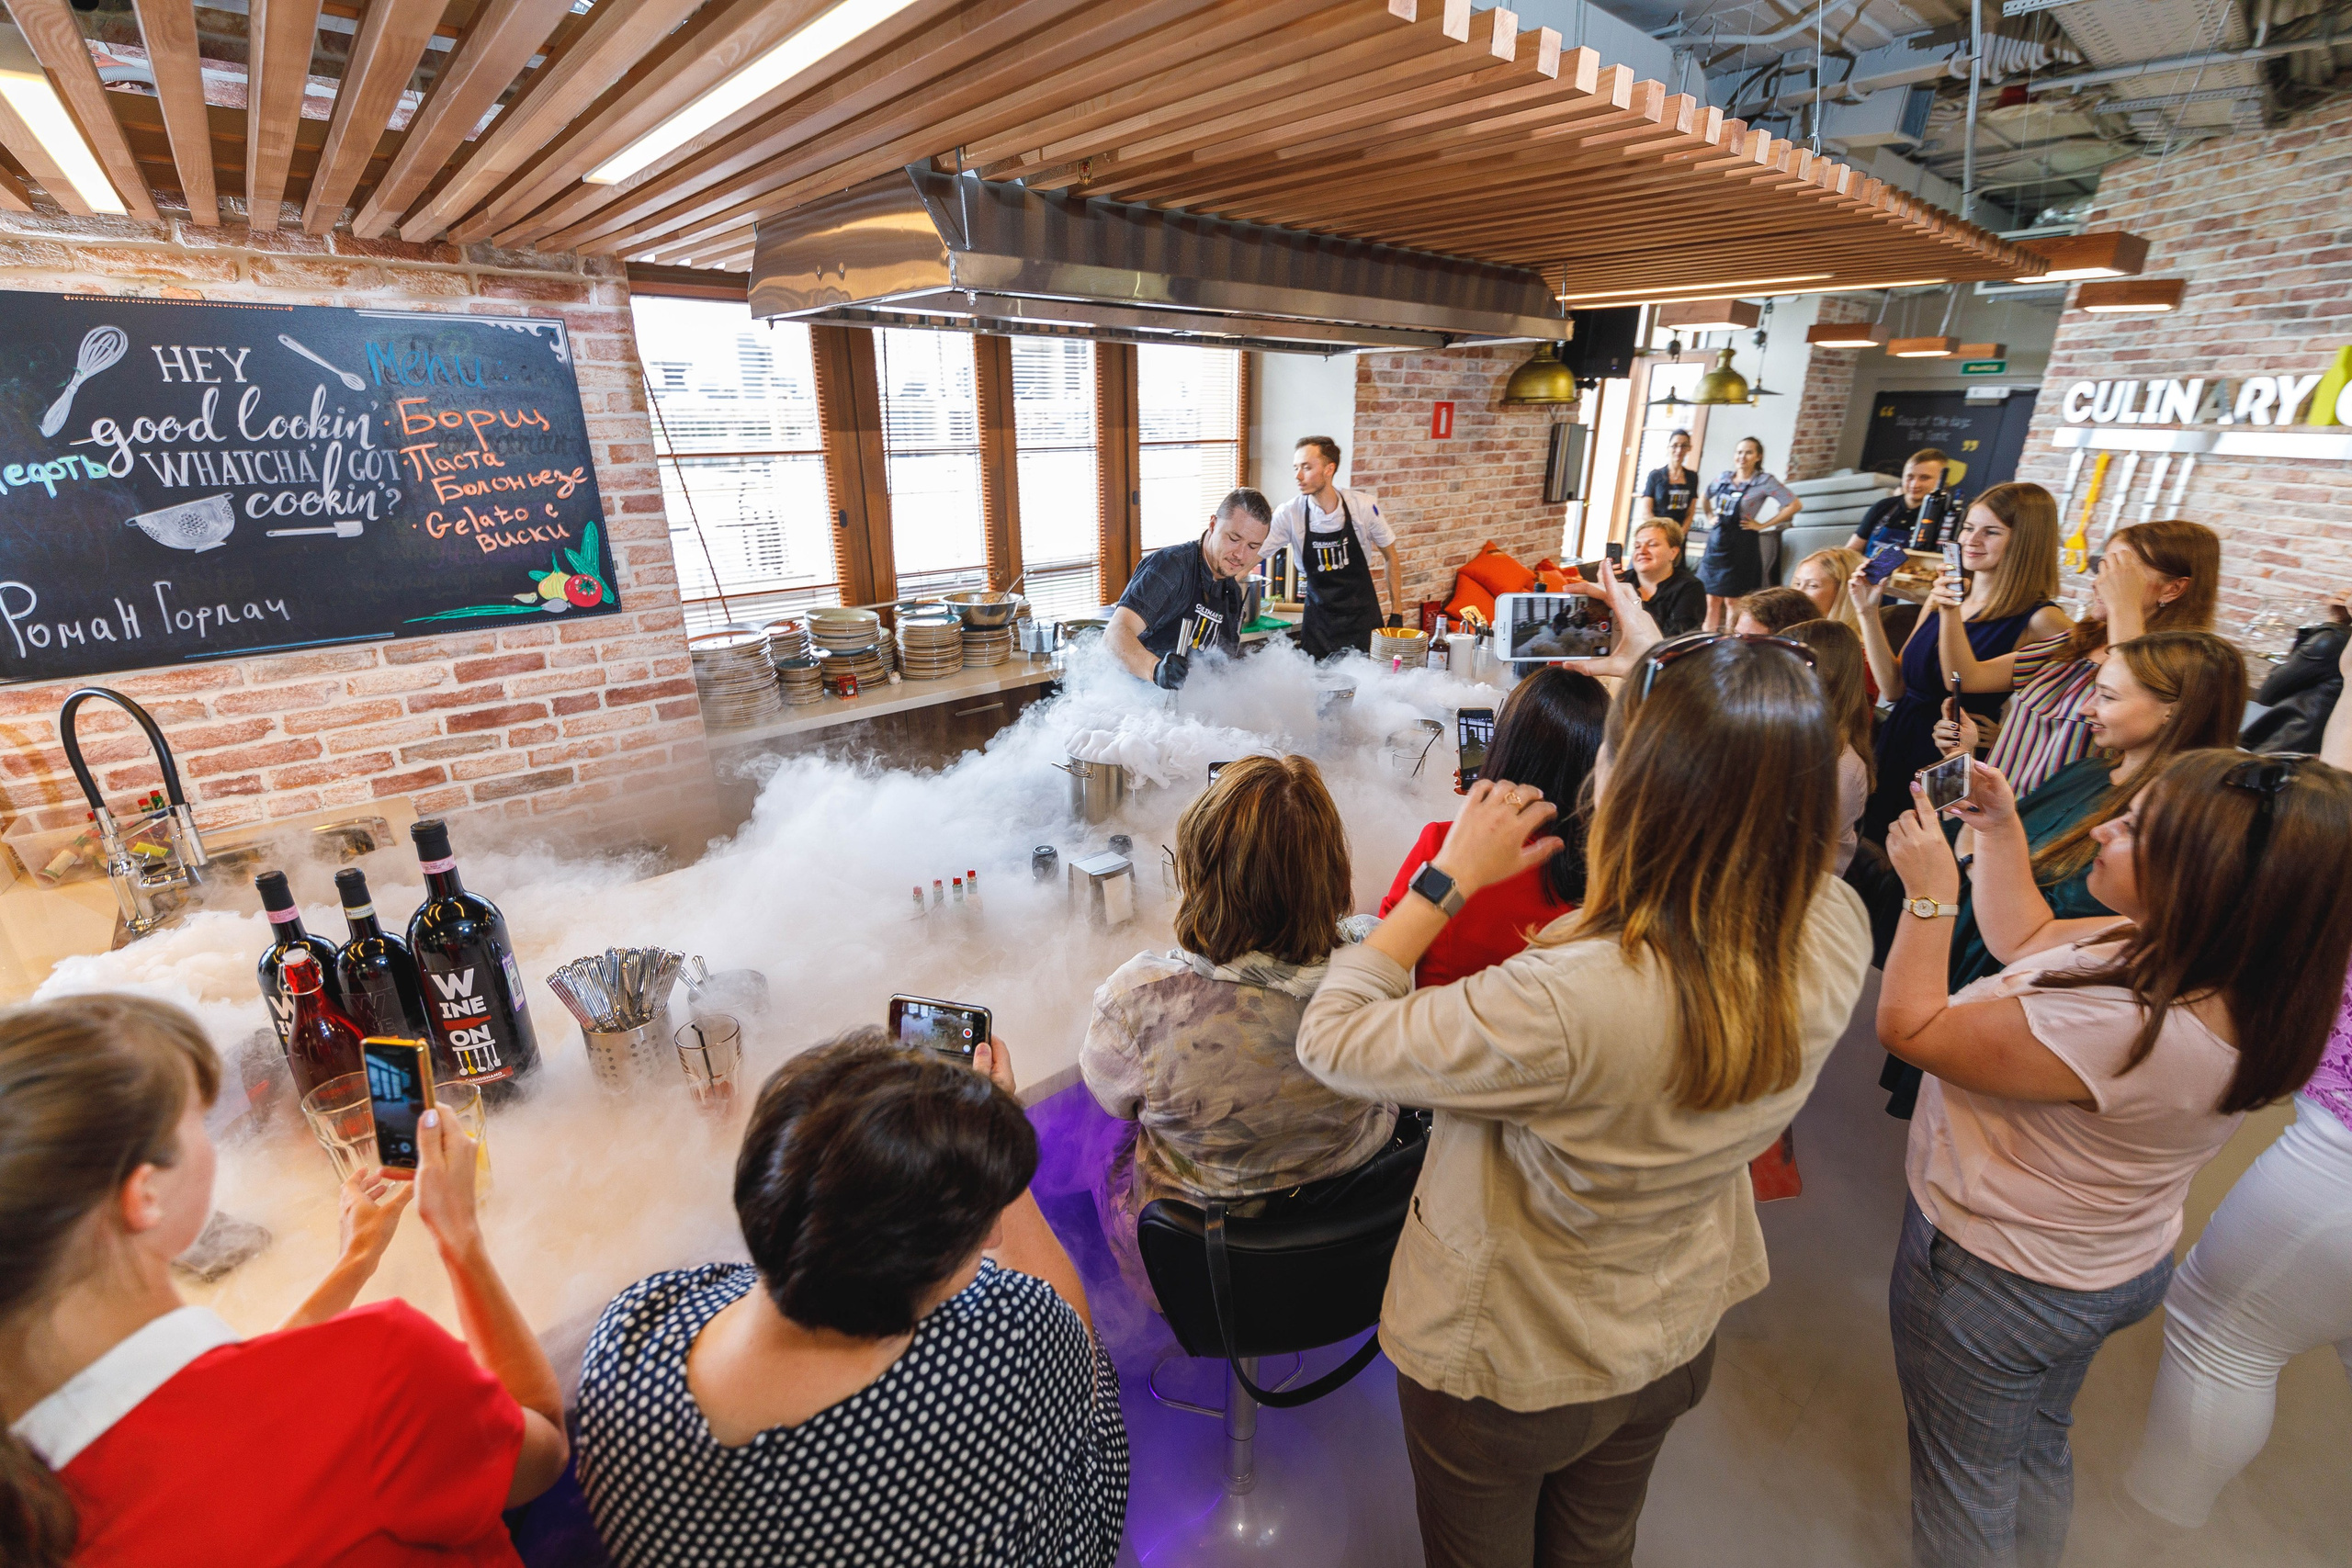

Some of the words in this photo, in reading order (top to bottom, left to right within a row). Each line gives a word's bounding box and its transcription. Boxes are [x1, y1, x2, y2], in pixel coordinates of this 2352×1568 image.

[151, 344, 252, 383] HEY
[2062, 375, 2324, 426] CULINARY
[69, 386, 228, 479] good
[396, 397, 550, 454] Борщ
[347, 448, 402, 481] GOT
[400, 442, 505, 482] Паста
[431, 466, 589, 505] Болоньезе
[425, 505, 529, 540] Gelato
[0, 581, 141, 659] Роман
[439, 995, 487, 1019] INE
[449, 1024, 491, 1047] ON
